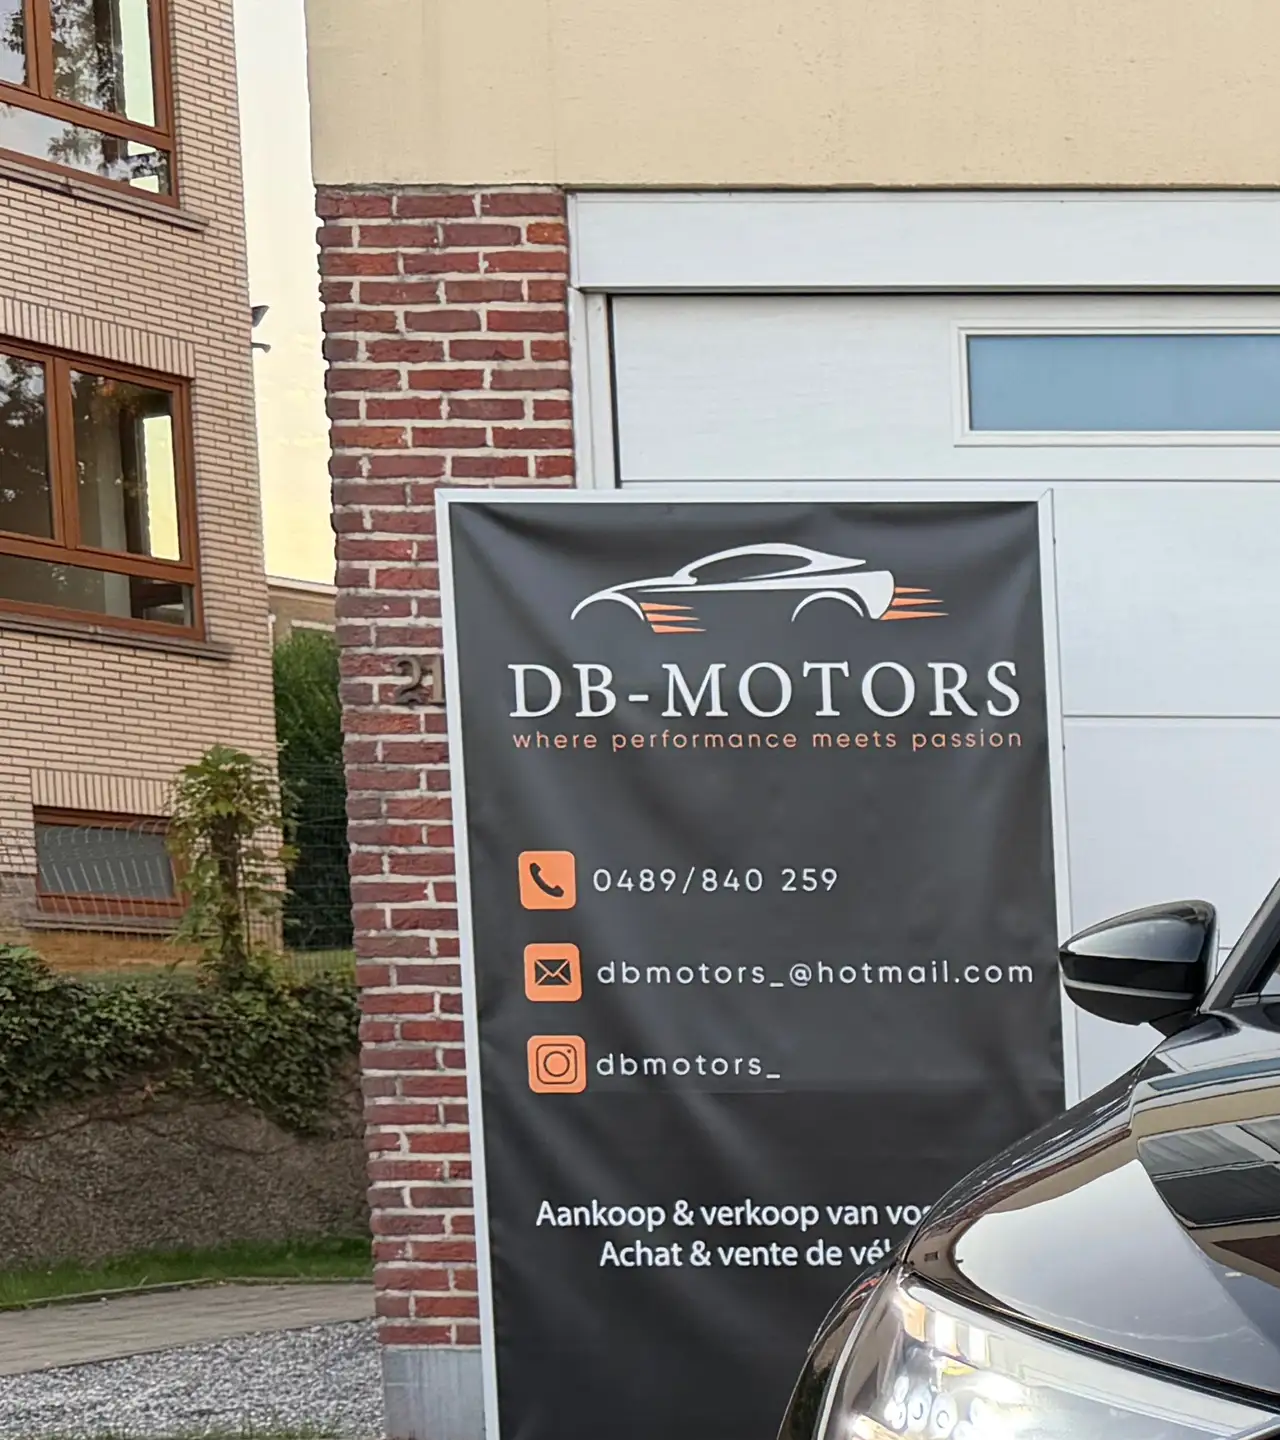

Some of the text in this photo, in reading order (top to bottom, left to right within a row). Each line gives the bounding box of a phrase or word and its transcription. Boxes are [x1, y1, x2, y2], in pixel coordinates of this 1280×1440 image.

[507, 660, 1020, 718] DB-MOTORS
[513, 728, 1023, 753] where performance meets passion
[593, 867, 839, 894] 0489/840 259
[597, 959, 1034, 988] dbmotors_@hotmail.com
[596, 1053, 781, 1079] dbmotors_
[535, 1199, 666, 1232] Aankoop
[672, 1199, 695, 1226] &
[700, 1199, 820, 1232] verkoop
[826, 1205, 878, 1225] van
[599, 1239, 682, 1266] Achat
[689, 1240, 712, 1267] &
[717, 1243, 799, 1266] vente
[806, 1239, 843, 1266] de
